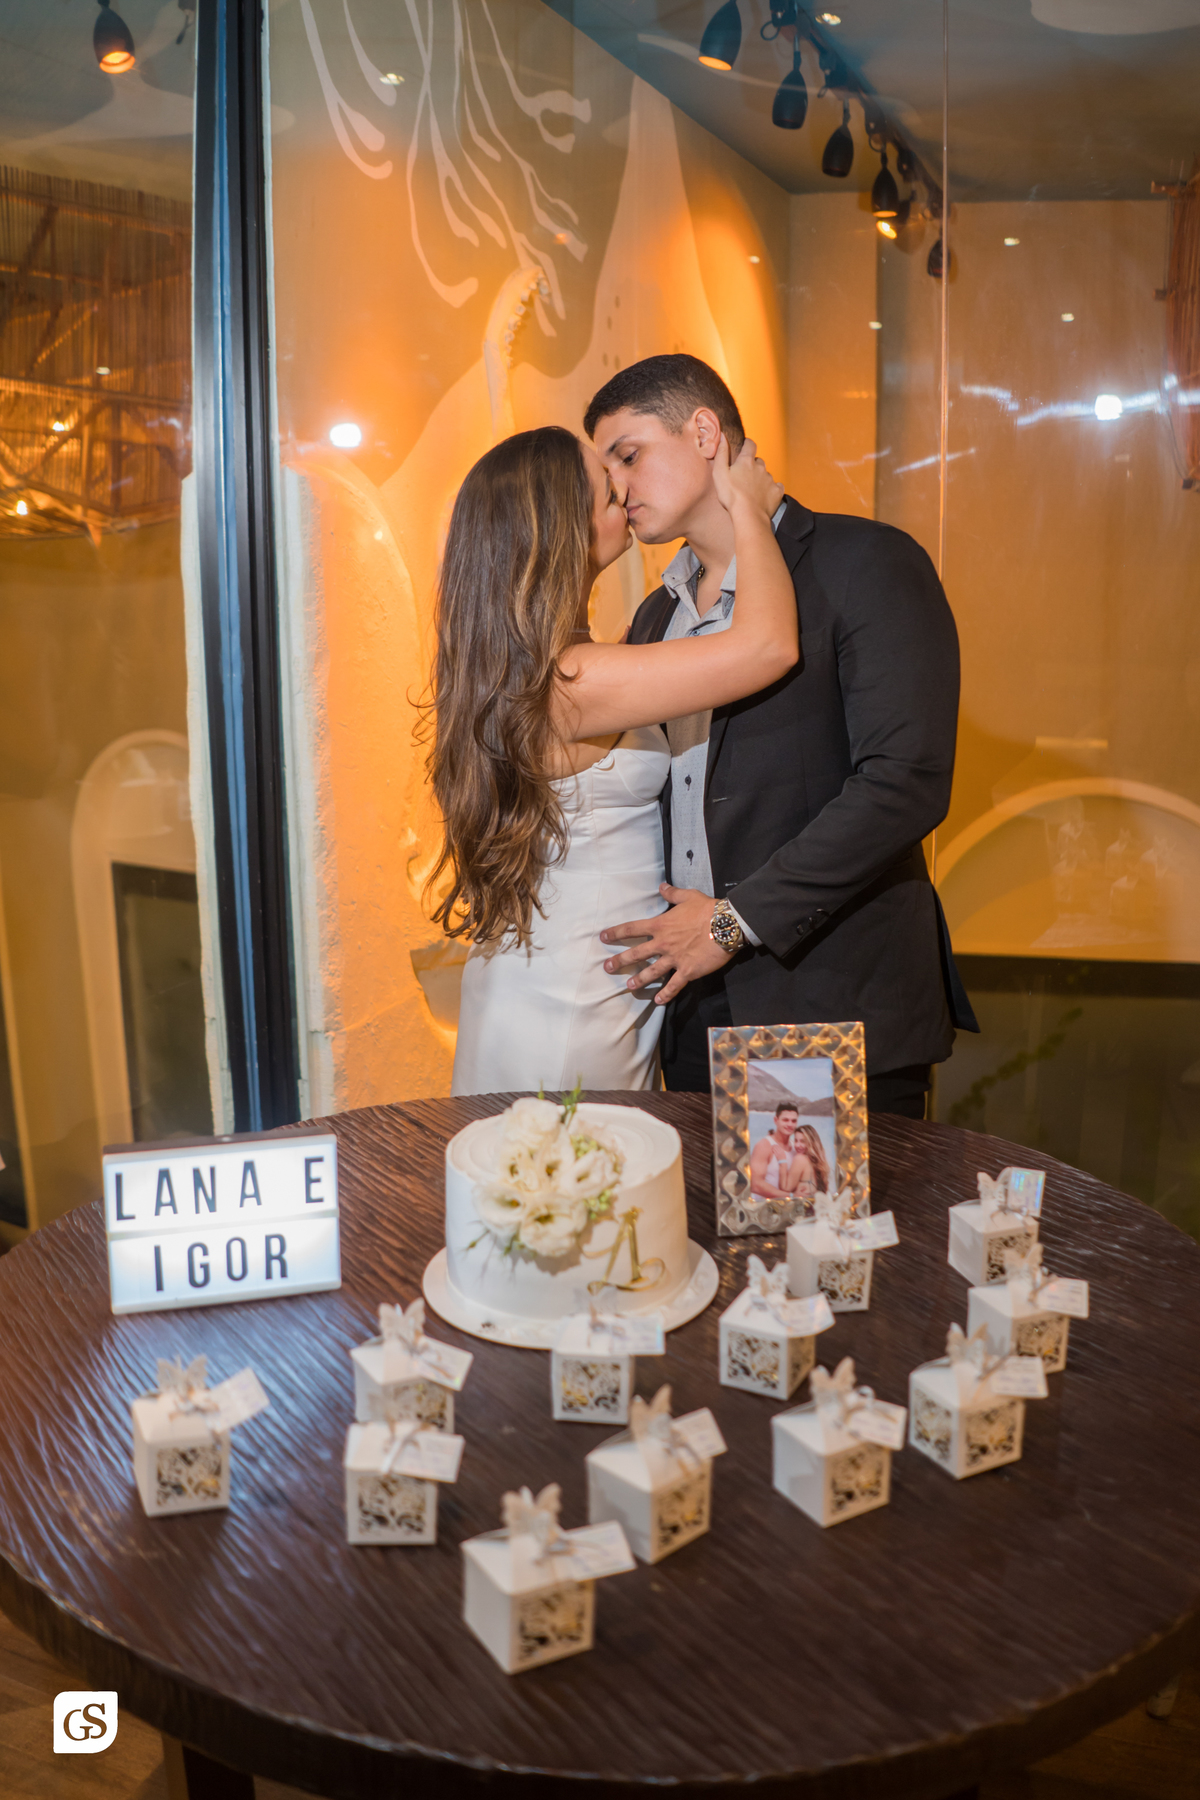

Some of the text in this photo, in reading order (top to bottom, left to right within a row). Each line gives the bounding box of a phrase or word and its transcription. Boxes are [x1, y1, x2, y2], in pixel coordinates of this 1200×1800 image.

[115, 1156, 325, 1222] LANA E
[154, 1233, 288, 1293] IGOR
